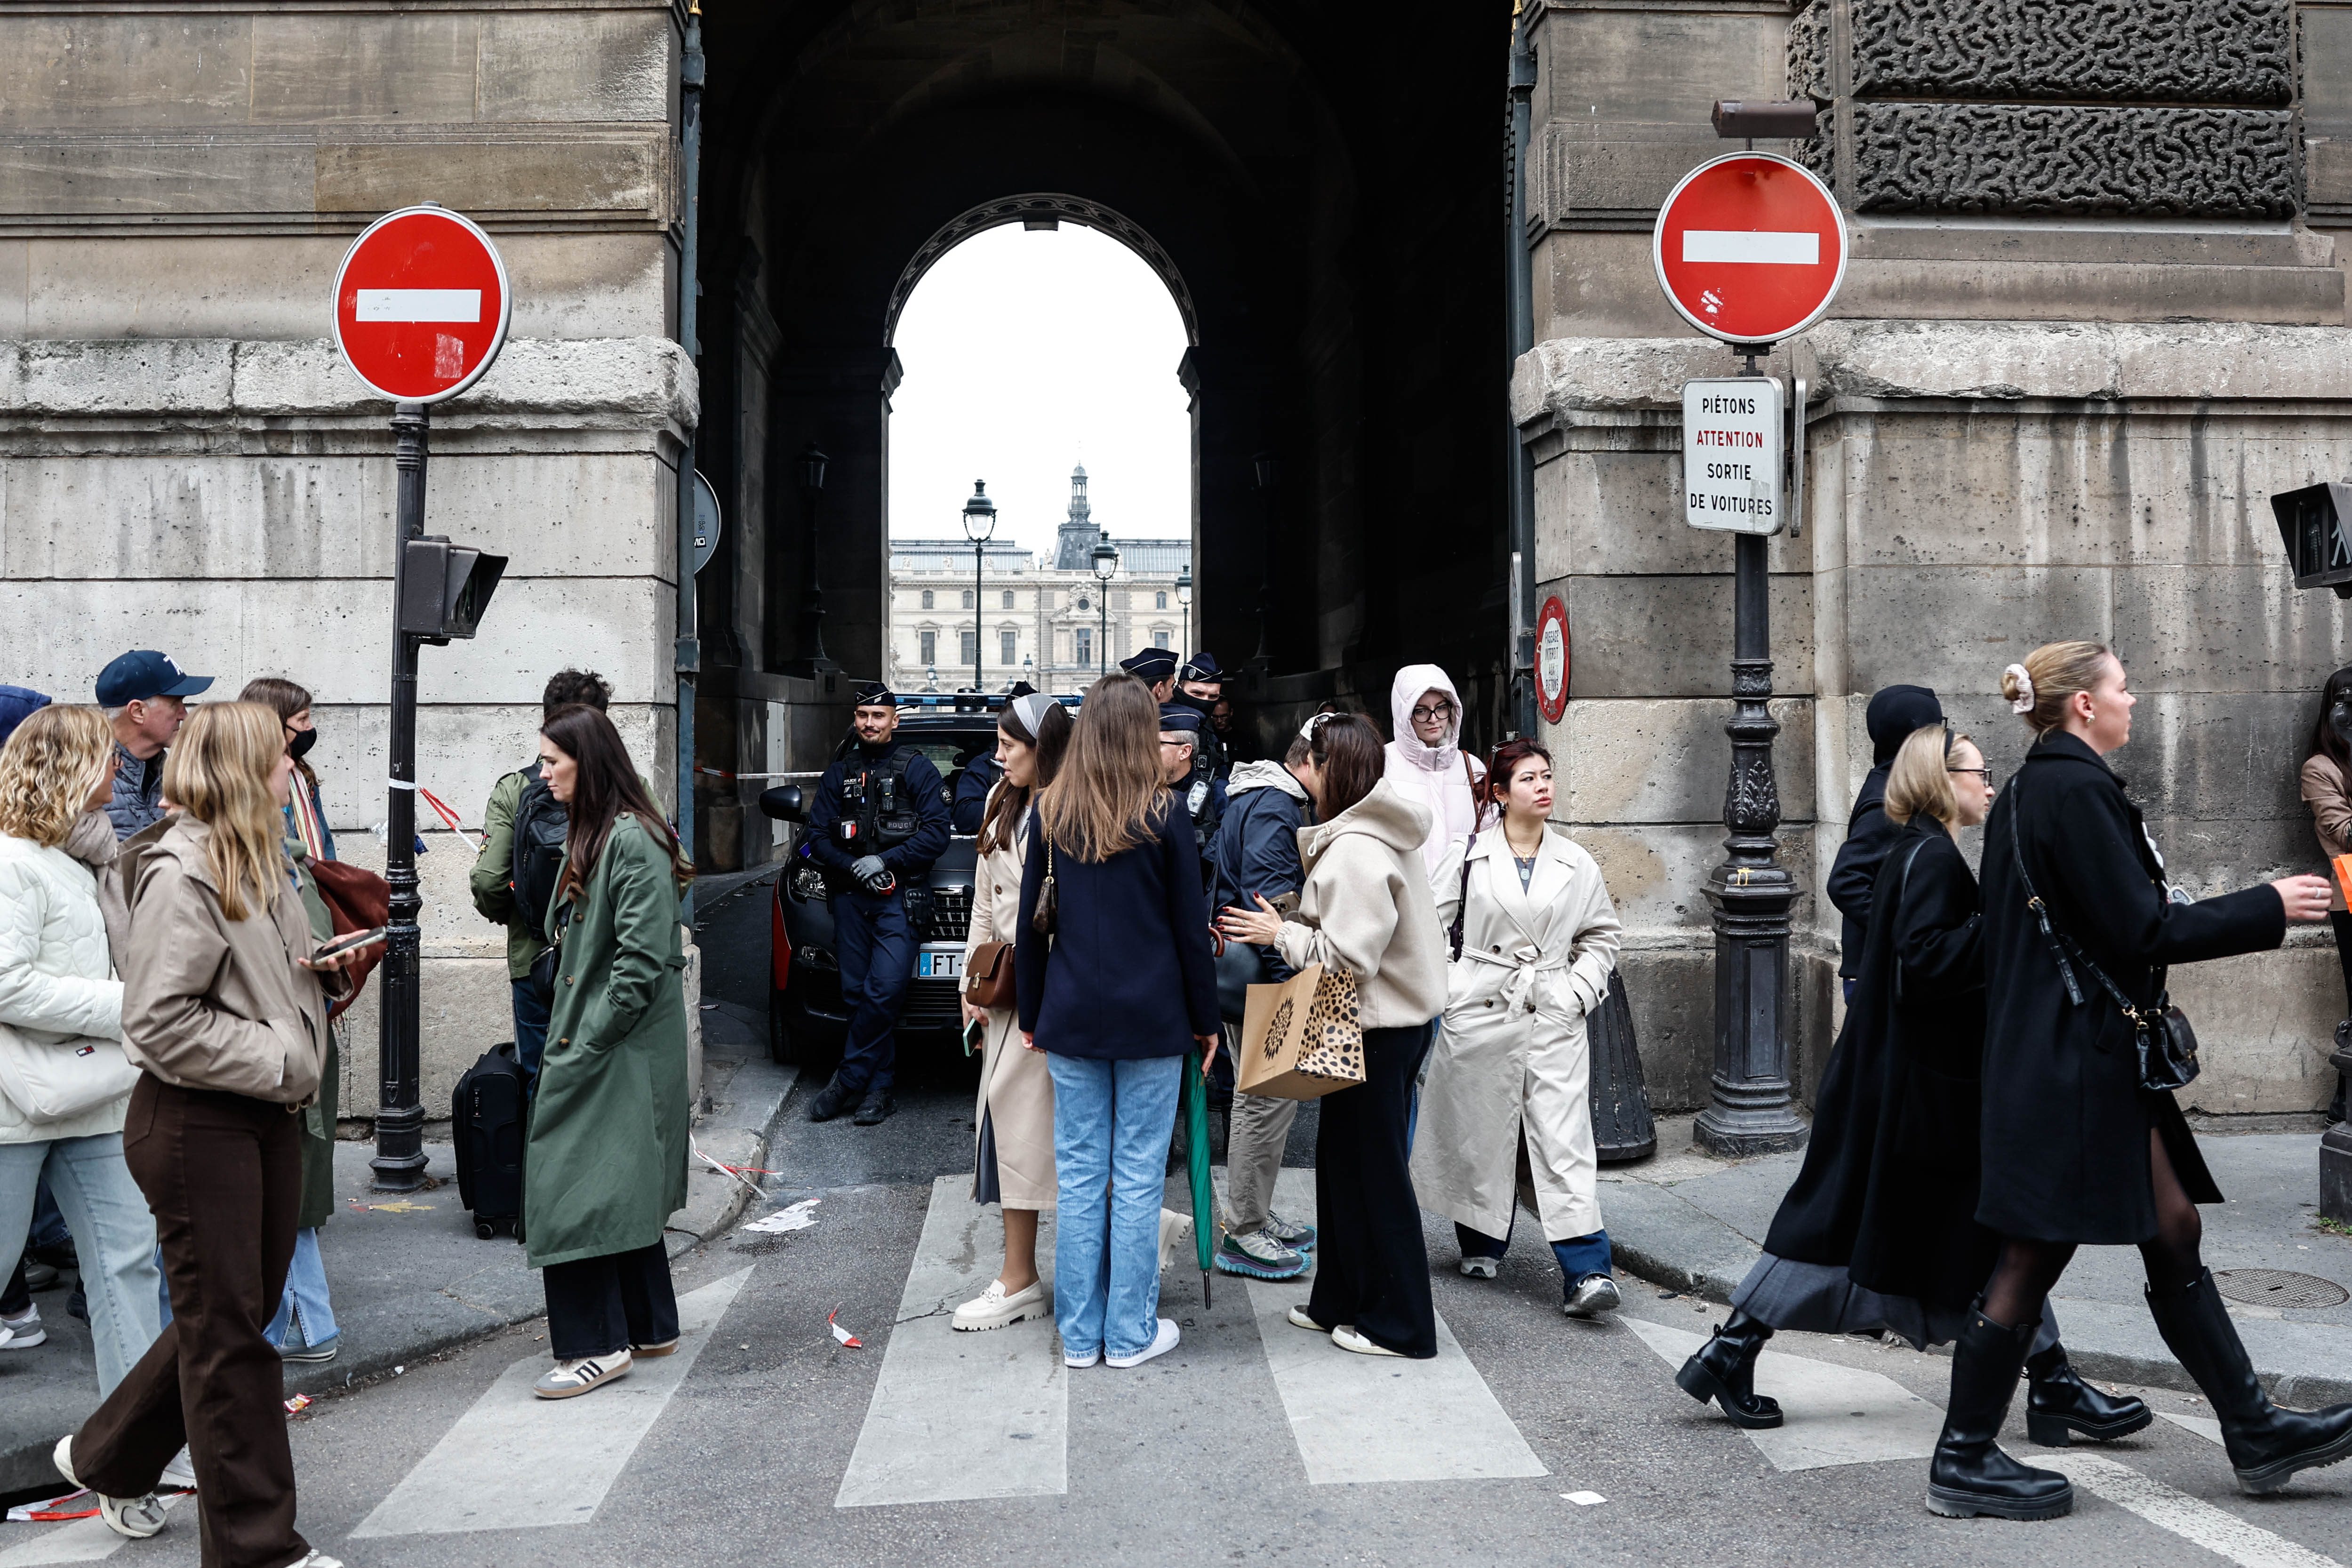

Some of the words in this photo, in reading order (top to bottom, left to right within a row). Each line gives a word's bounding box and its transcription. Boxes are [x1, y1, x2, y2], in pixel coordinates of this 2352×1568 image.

[1703, 395, 1755, 414] PIÉTONS
[1696, 430, 1763, 448] ATTENTION
[1707, 463, 1752, 480] SORTIE
[1690, 493, 1705, 509] DE
[1711, 495, 1772, 515] VOITURES
[1545, 630, 1559, 644] PASSAGE
[1545, 647, 1559, 661] INTERDIT
